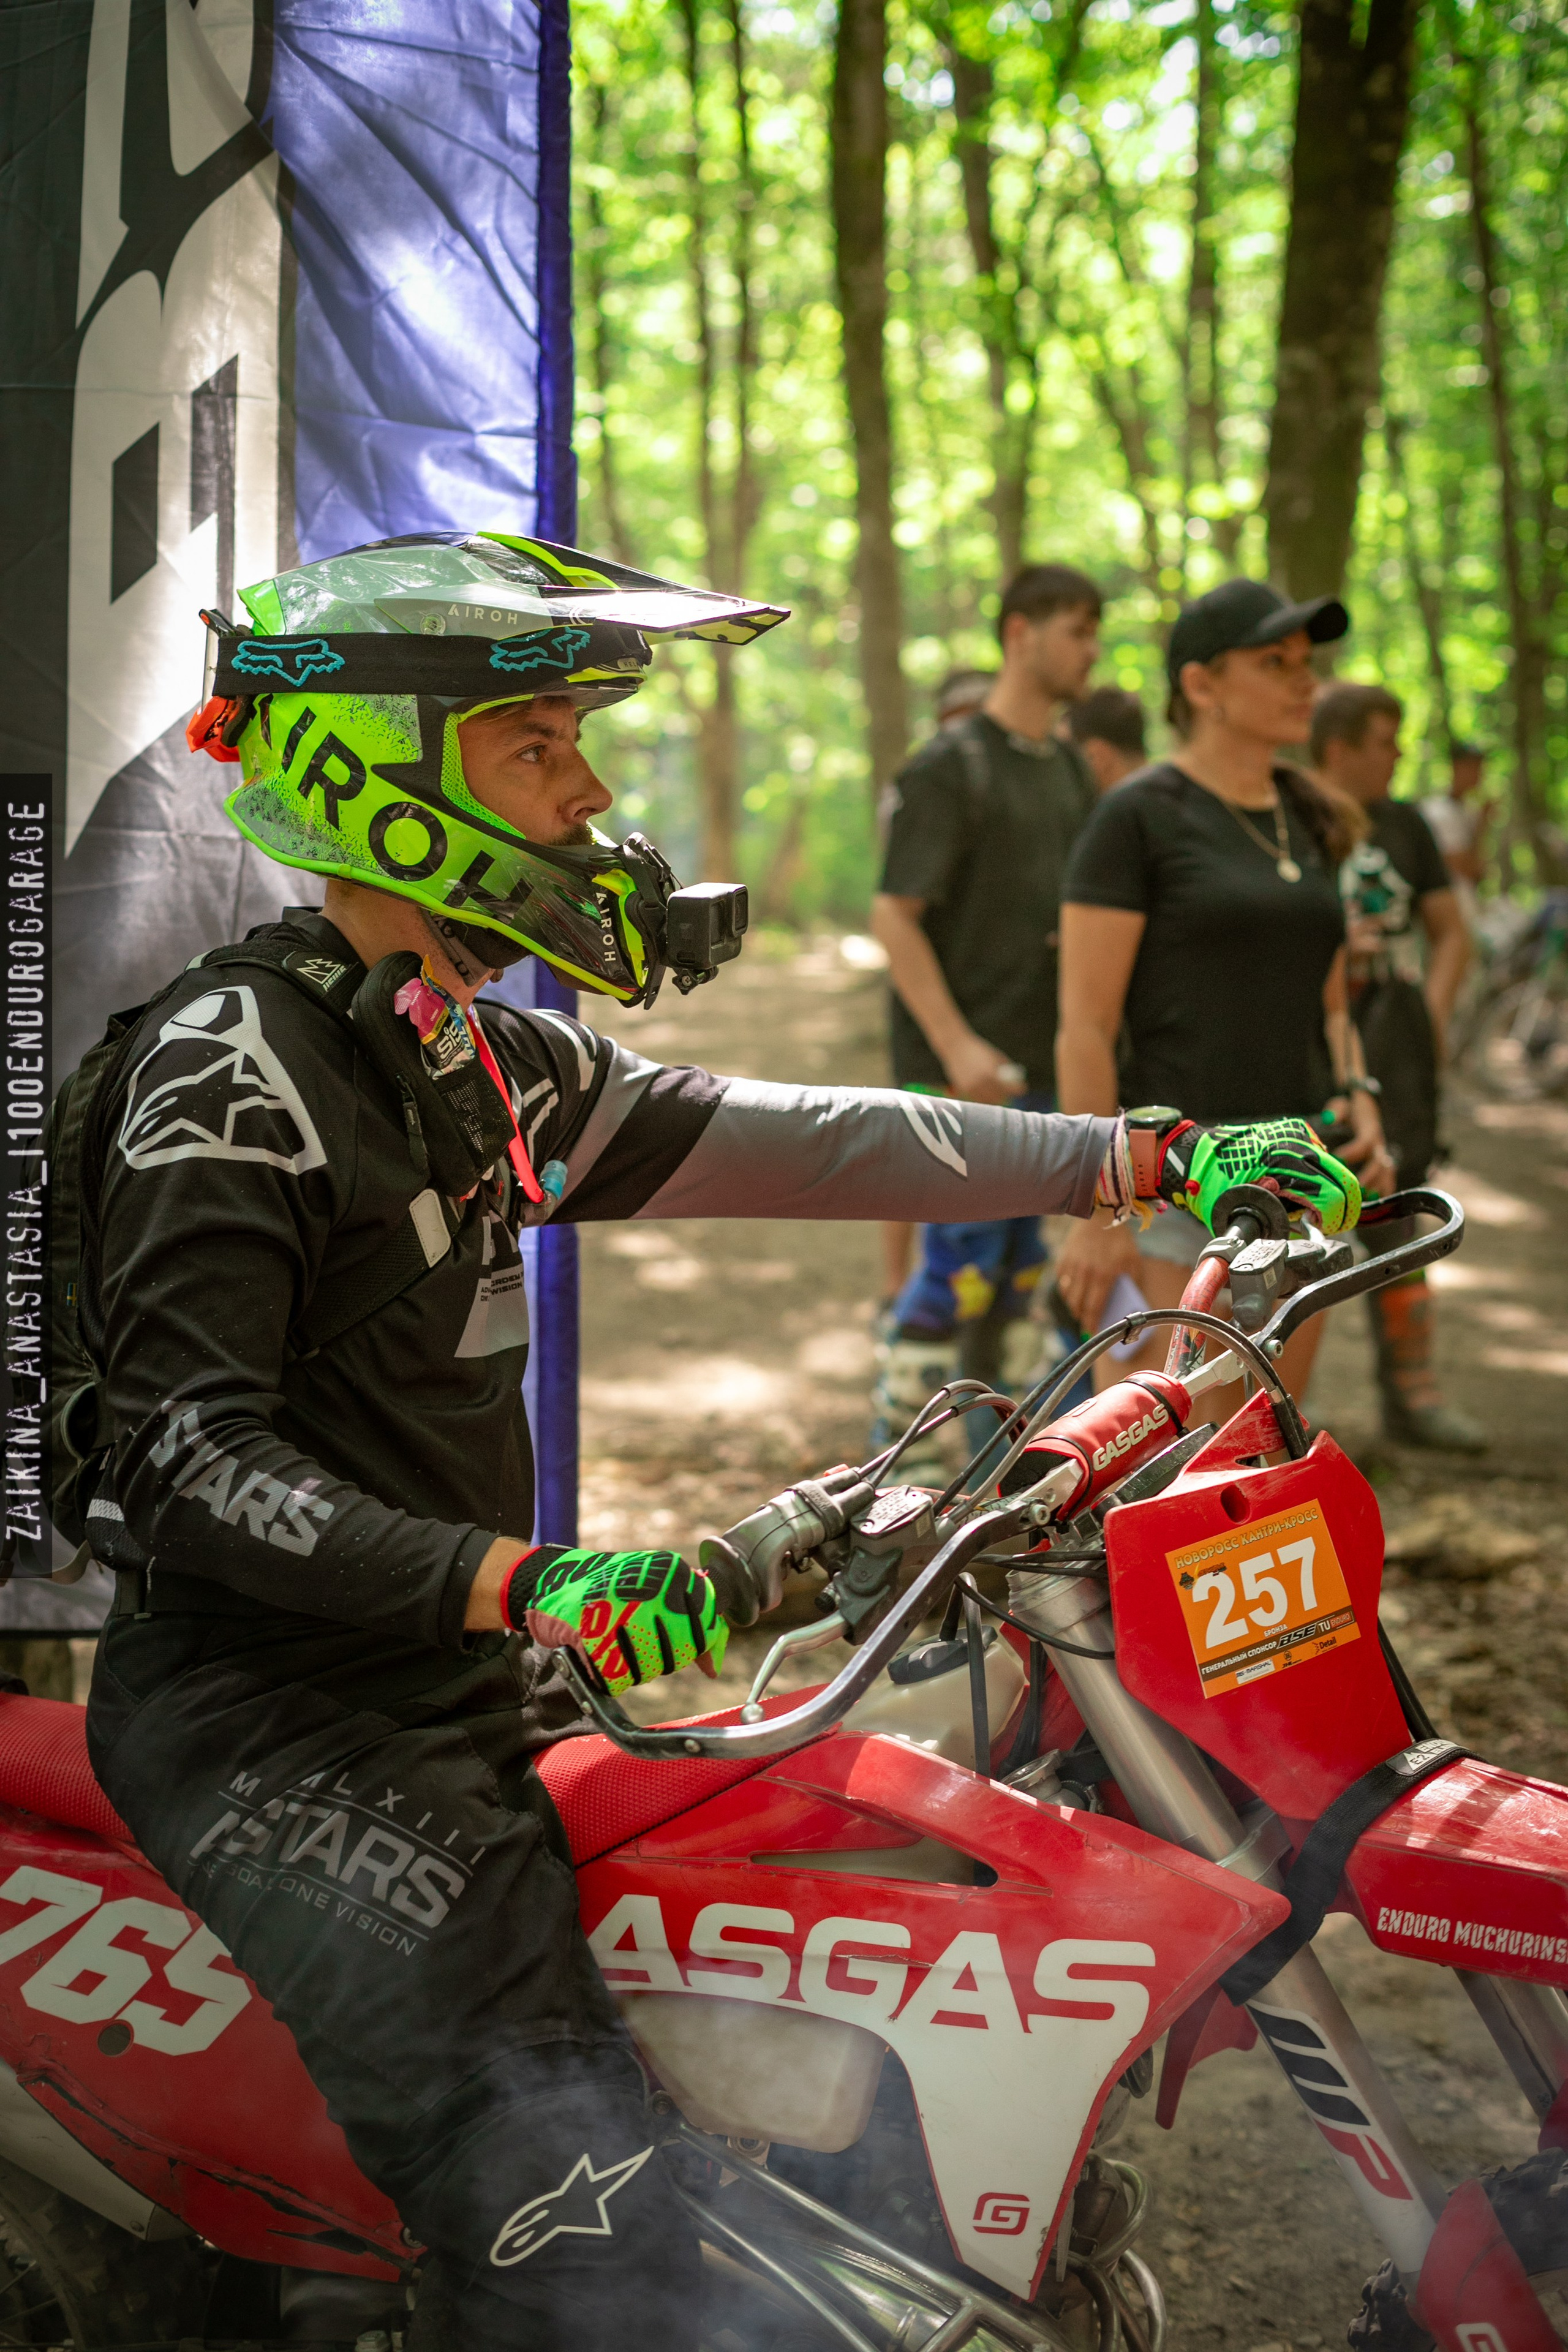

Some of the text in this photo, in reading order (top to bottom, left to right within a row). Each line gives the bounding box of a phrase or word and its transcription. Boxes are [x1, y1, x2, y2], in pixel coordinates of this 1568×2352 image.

[447, 603, 518, 625] AIROH
[595, 892, 616, 962] AIROH
[1091, 1403, 1170, 1471] GASGAS
[1175, 1507, 1318, 1569] НОВОРОСС КАНТРИ-КРОСС
[1192, 1536, 1317, 1649] 257
[1201, 1651, 1248, 1675] ГЕНЕРАЛЬНЫЙ
[1247, 1641, 1278, 1657] СПОНСОР
[1264, 1624, 1288, 1638] БРОНЗА
[1319, 1636, 1337, 1650] Detail
[335, 1901, 417, 1956] VISION
[1377, 1906, 1568, 1964] ENDURO MUCHURINS
[587, 1893, 1156, 2041] ASGAS
